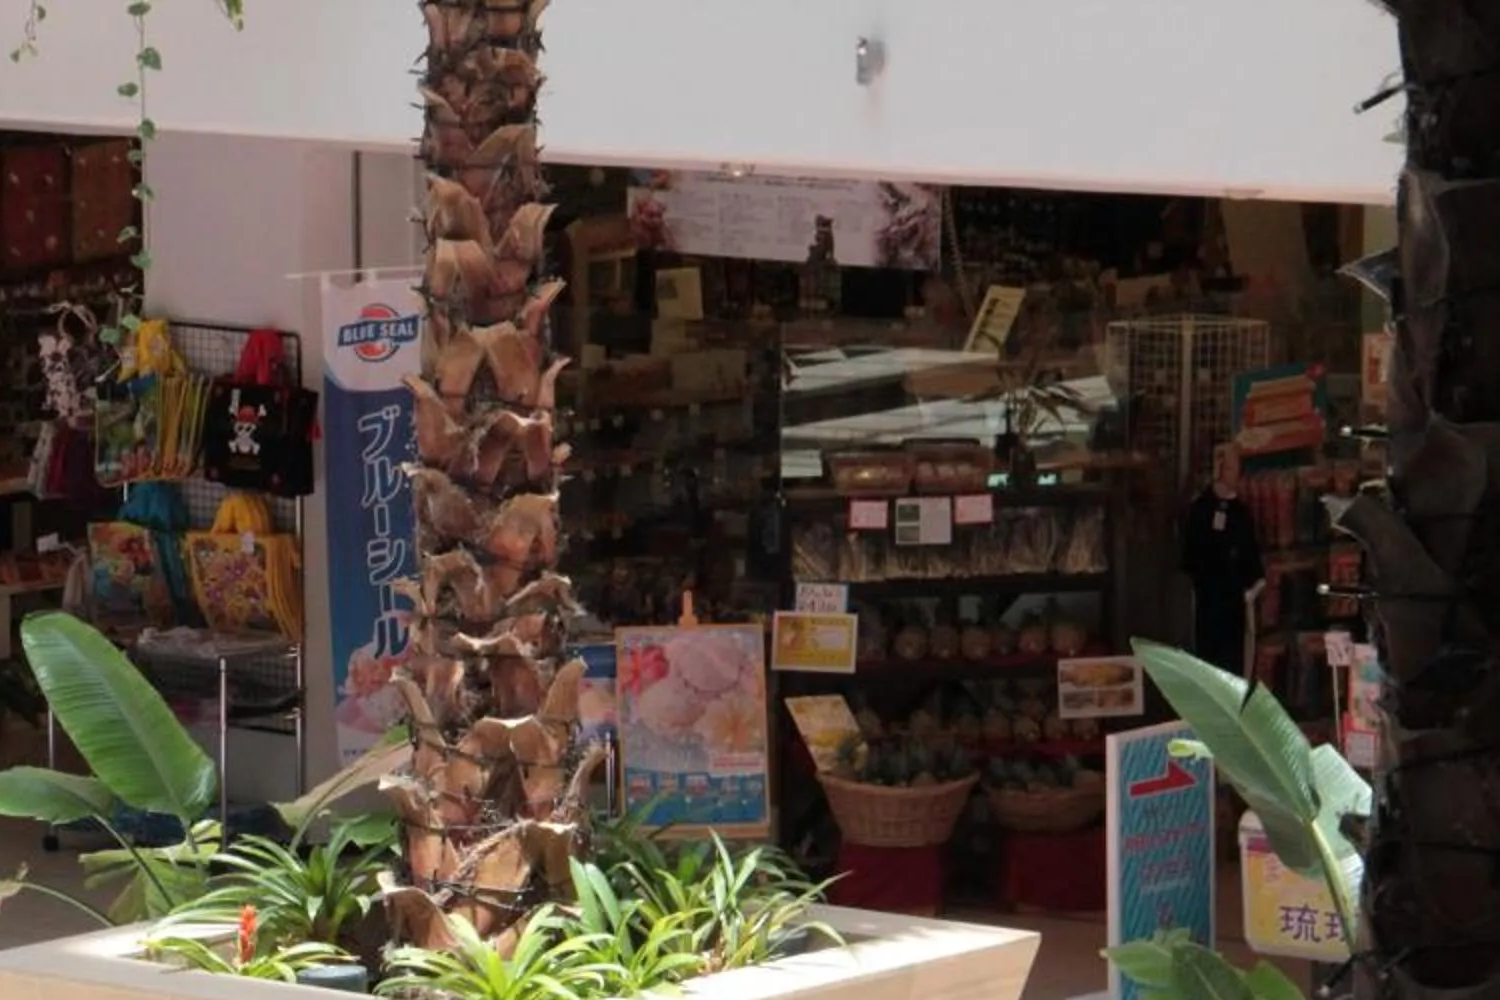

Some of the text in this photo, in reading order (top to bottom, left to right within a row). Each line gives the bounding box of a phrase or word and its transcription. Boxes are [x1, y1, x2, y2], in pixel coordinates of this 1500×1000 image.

[344, 320, 415, 343] BLUE SEAL
[357, 404, 410, 660] ブルーシール
